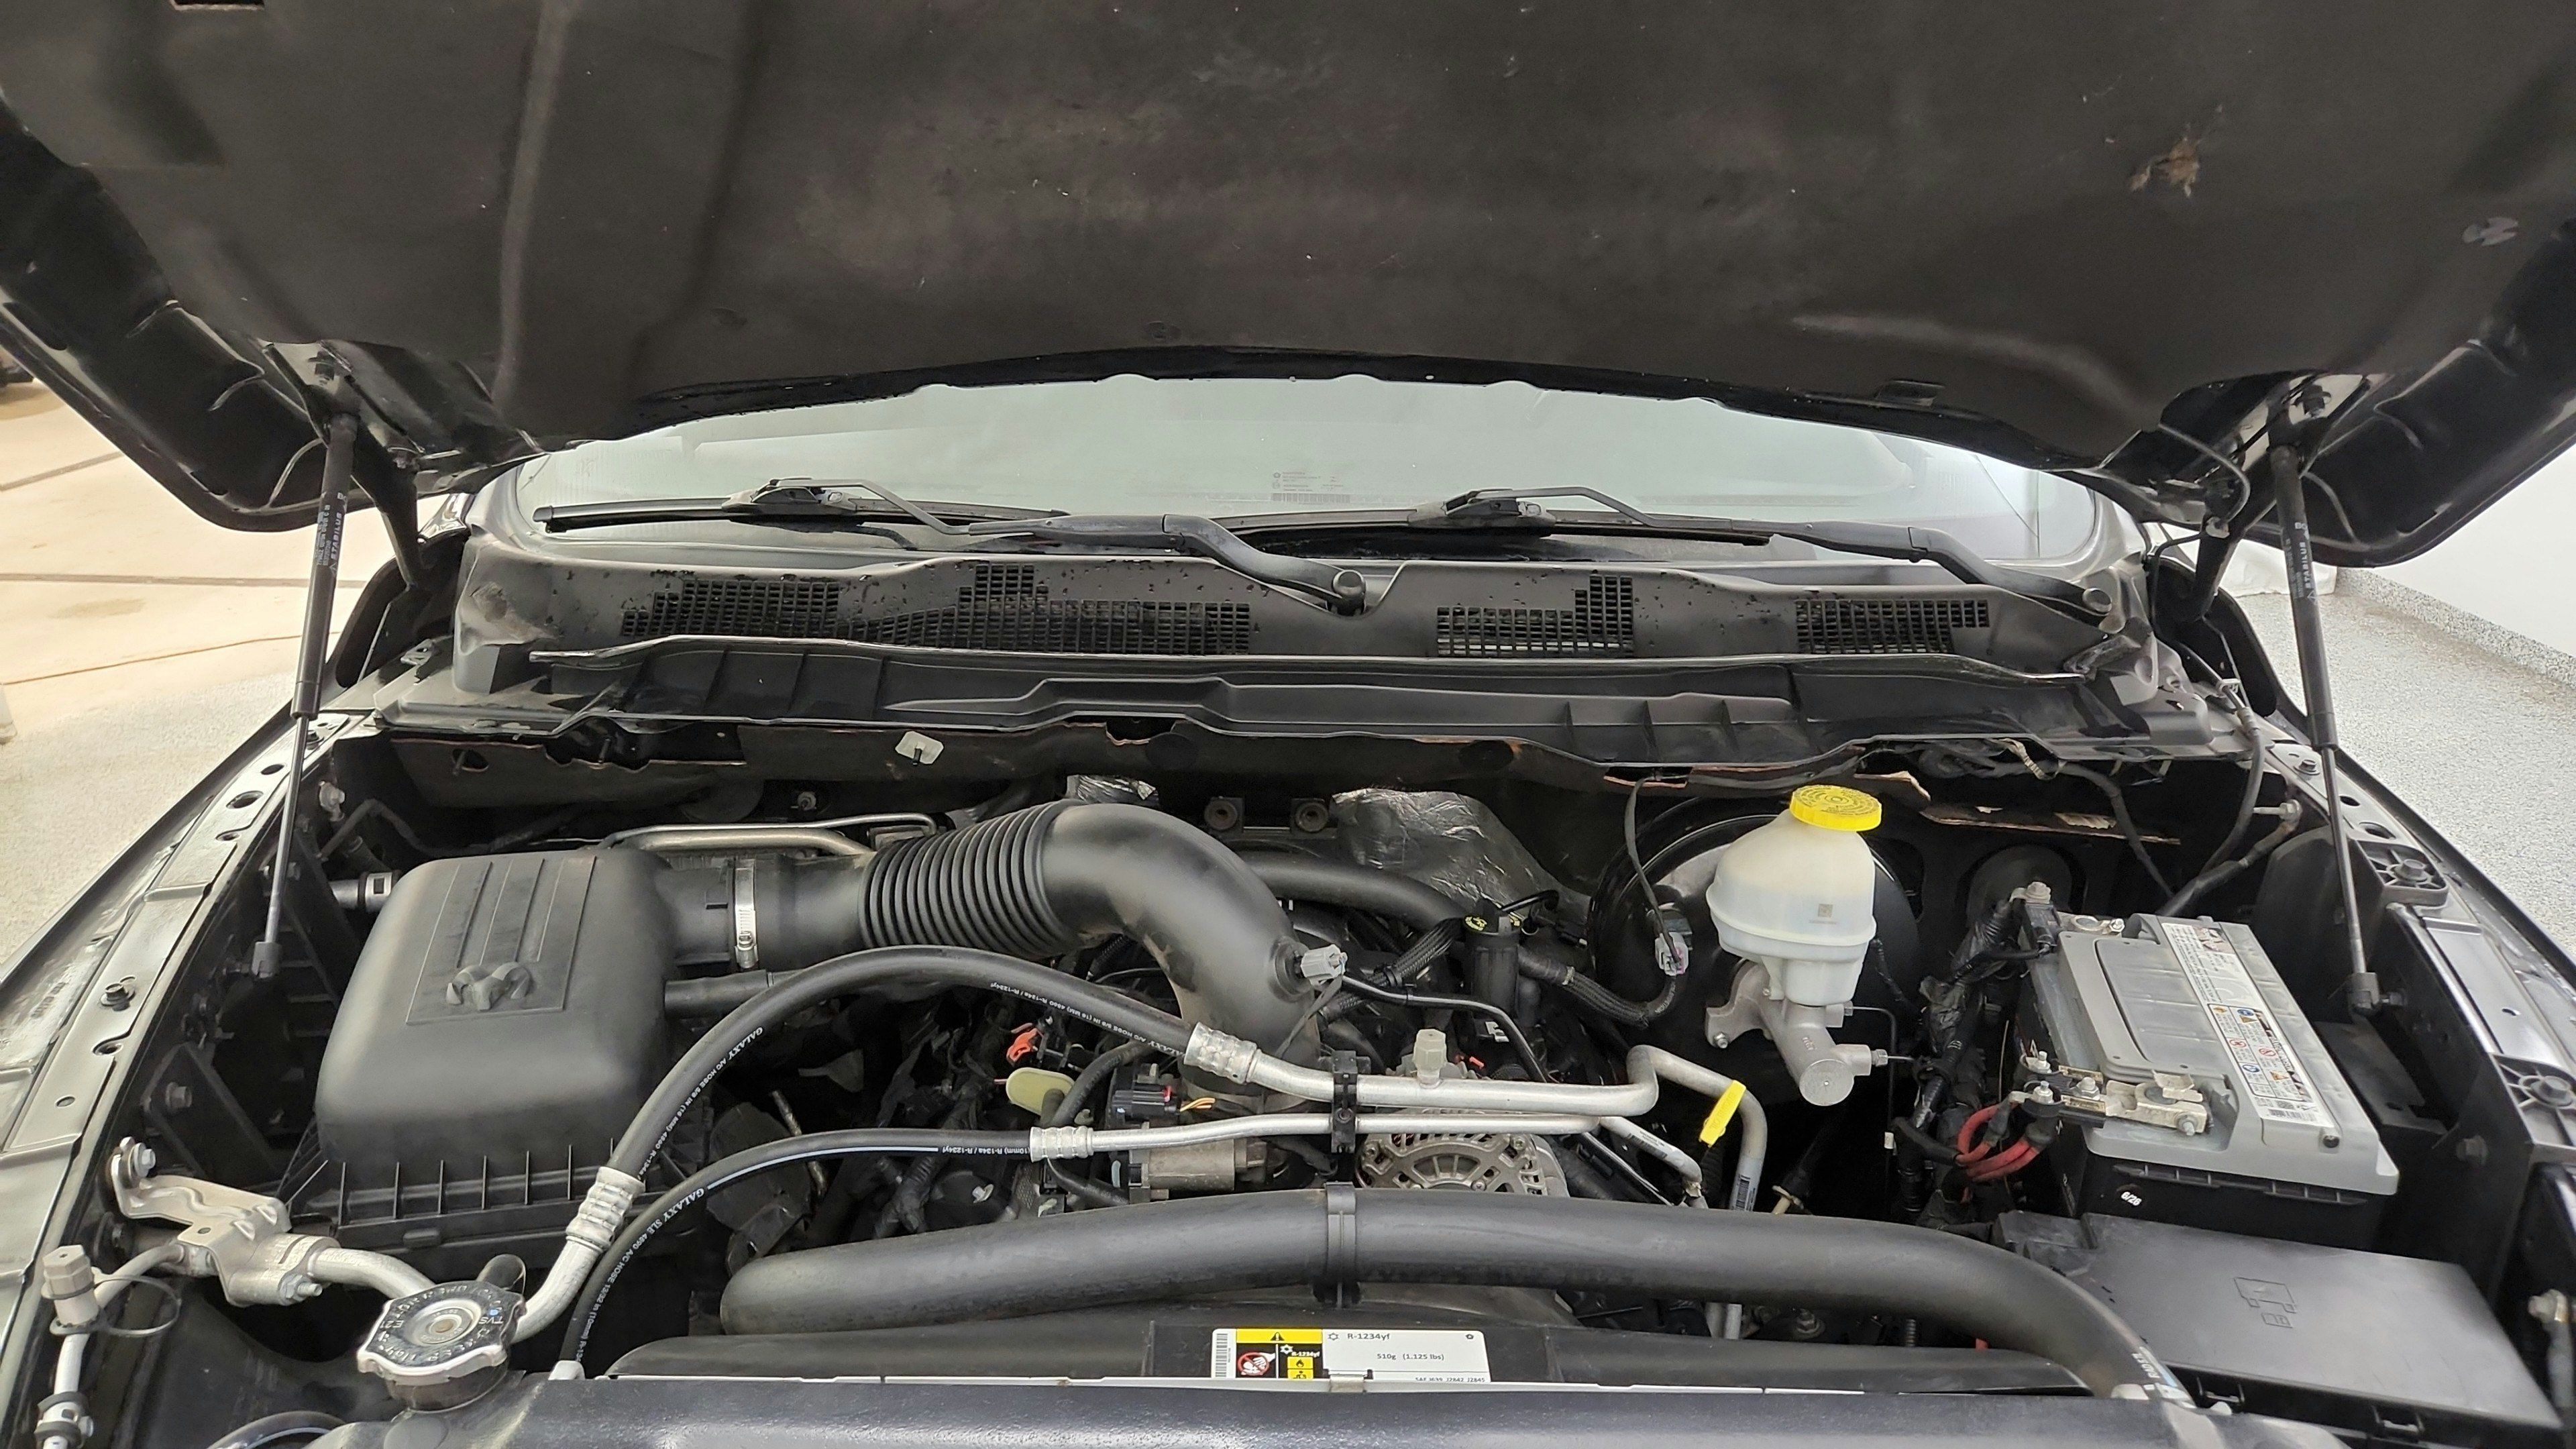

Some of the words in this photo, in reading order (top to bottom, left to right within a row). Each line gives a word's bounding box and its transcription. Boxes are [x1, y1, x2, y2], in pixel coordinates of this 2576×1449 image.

[729, 1026, 763, 1061] GALAXY
[1148, 1040, 1184, 1057] ALAXY
[716, 1058, 727, 1071] A/C
[699, 1070, 716, 1089] HOSE
[942, 1146, 973, 1154] R-1234yf
[663, 1187, 704, 1223] GALAXY
[2121, 1191, 2143, 1206] 6/26
[622, 1250, 634, 1264] A/C
[608, 1261, 625, 1284] HOSE
[596, 1283, 611, 1304] 13/32
[1347, 1332, 1391, 1340] R-1234yf
